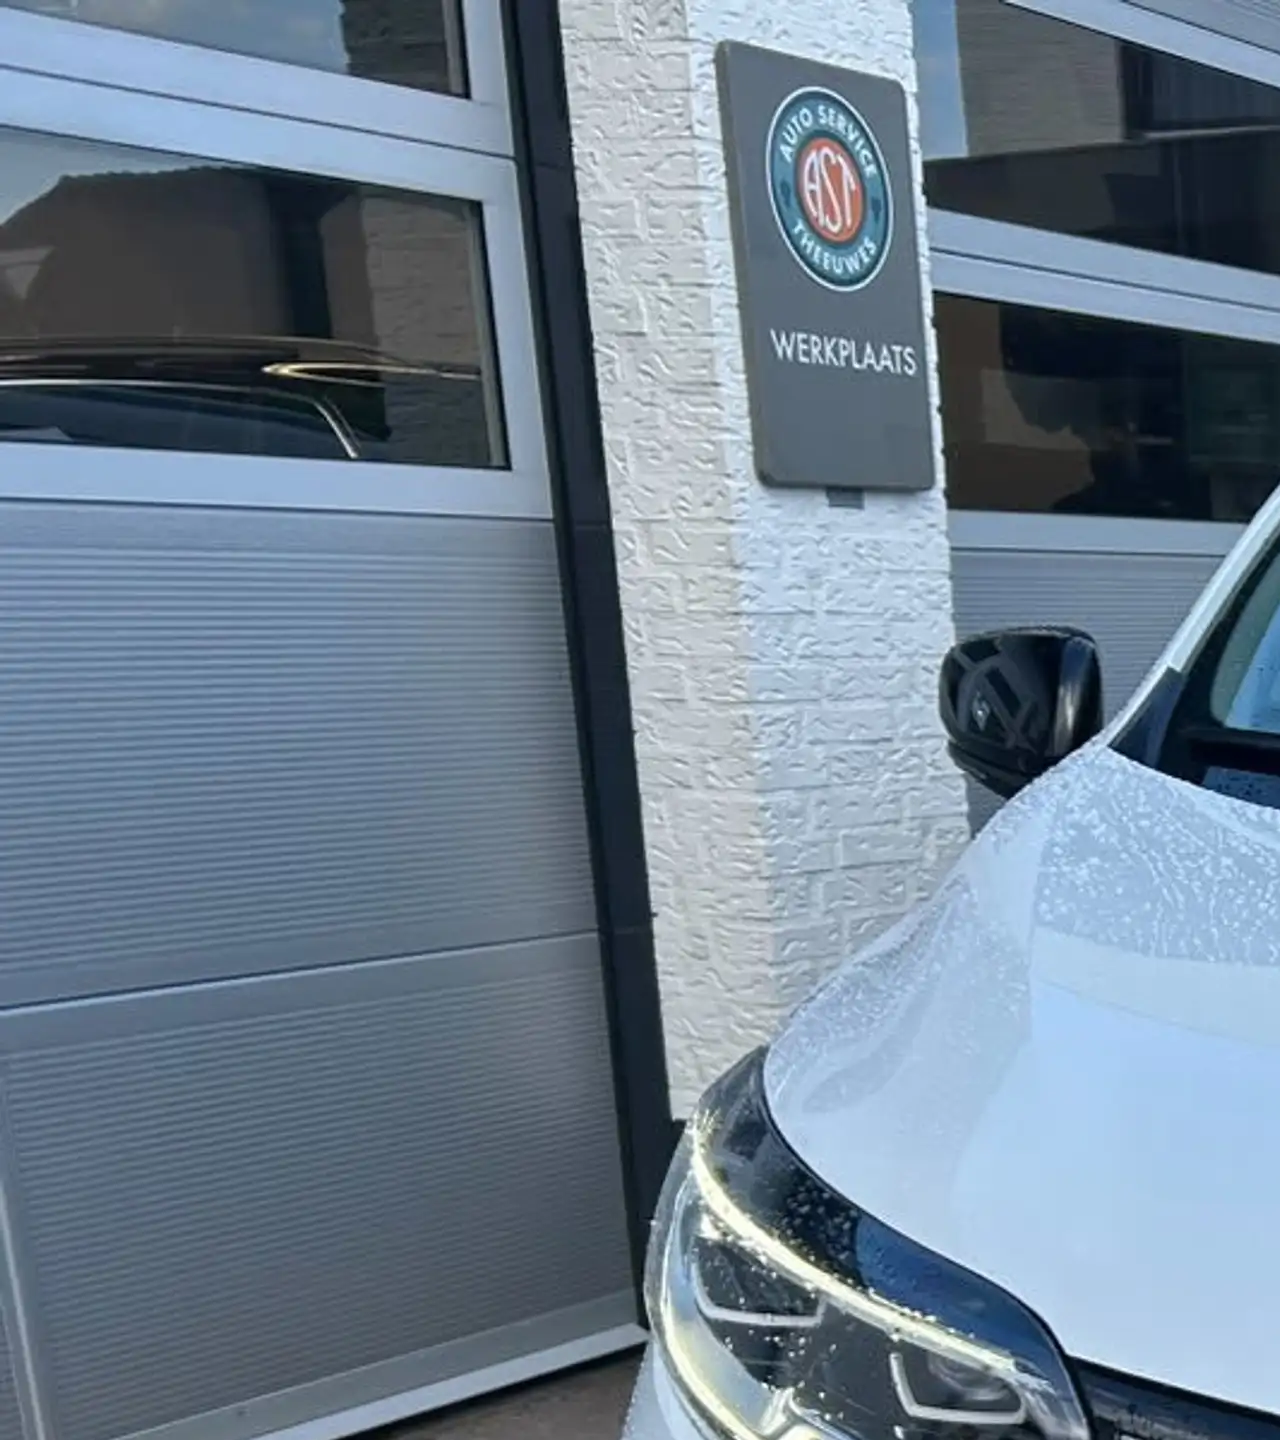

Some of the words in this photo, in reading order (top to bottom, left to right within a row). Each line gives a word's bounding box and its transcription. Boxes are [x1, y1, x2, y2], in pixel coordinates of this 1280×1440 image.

[779, 106, 814, 163] AUTO
[818, 105, 877, 178] SERVICE
[801, 145, 857, 235] AST
[791, 219, 877, 275] THEEUWES
[769, 328, 918, 376] WERKPLAATS
